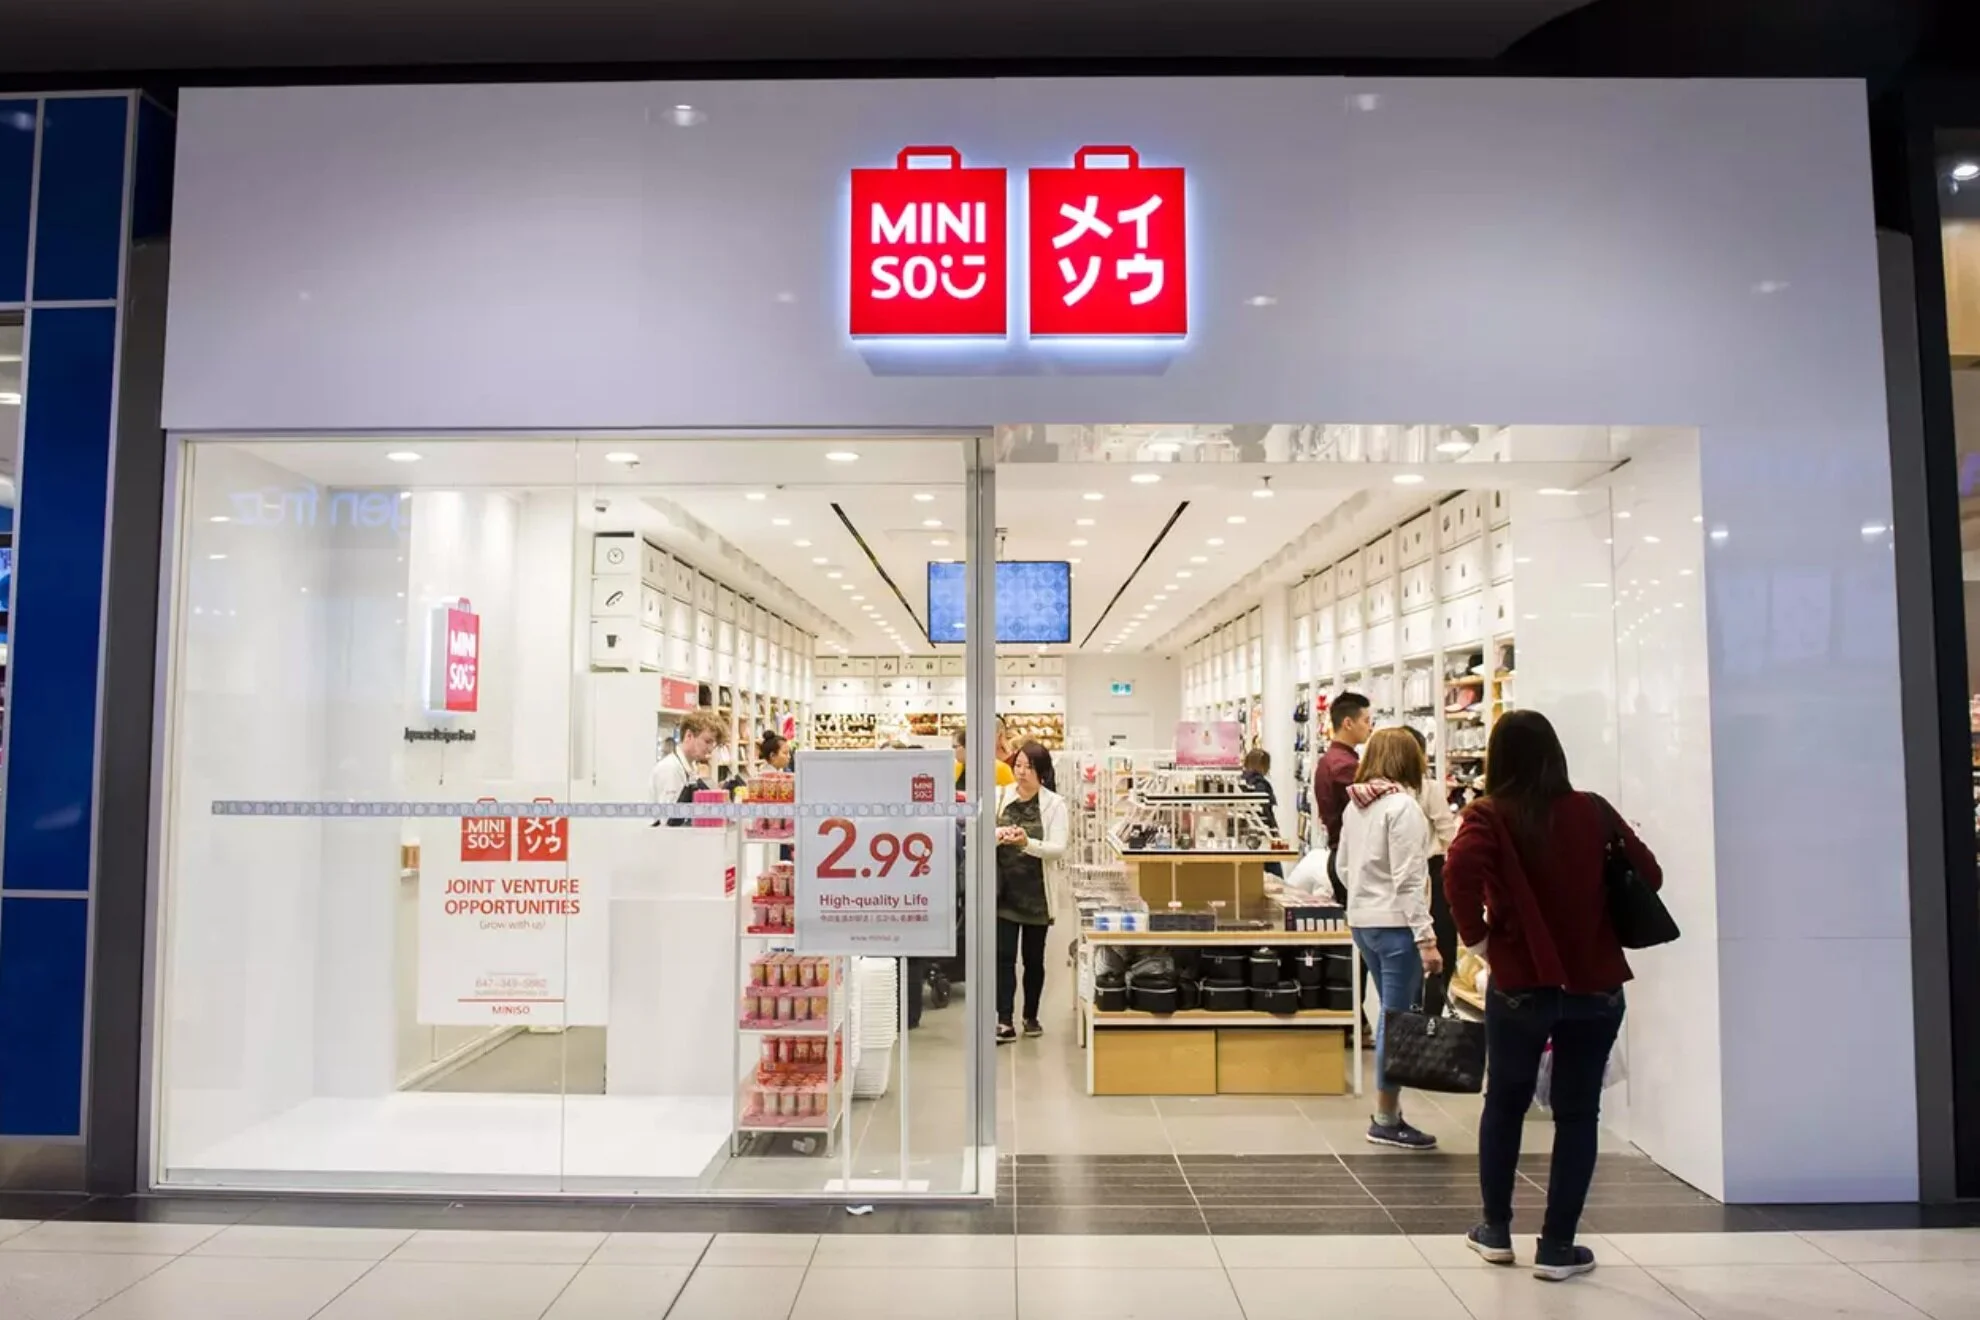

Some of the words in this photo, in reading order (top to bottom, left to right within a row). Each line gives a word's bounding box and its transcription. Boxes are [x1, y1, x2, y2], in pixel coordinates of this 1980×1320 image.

[871, 202, 986, 244] MINI
[1052, 194, 1163, 249] メイ
[1058, 253, 1164, 307] ソウ
[467, 819, 505, 833] MINI
[527, 835, 562, 853] ソウ
[816, 817, 933, 878] 2.99
[445, 879, 495, 894] JOINT
[501, 879, 579, 894] VENTURE
[445, 899, 580, 915] OPPORTUNITIES
[820, 894, 900, 908] High-quality
[904, 894, 928, 906] Life
[479, 919, 505, 931] Grow
[508, 919, 531, 930] with
[492, 1006, 530, 1015] MINISO
